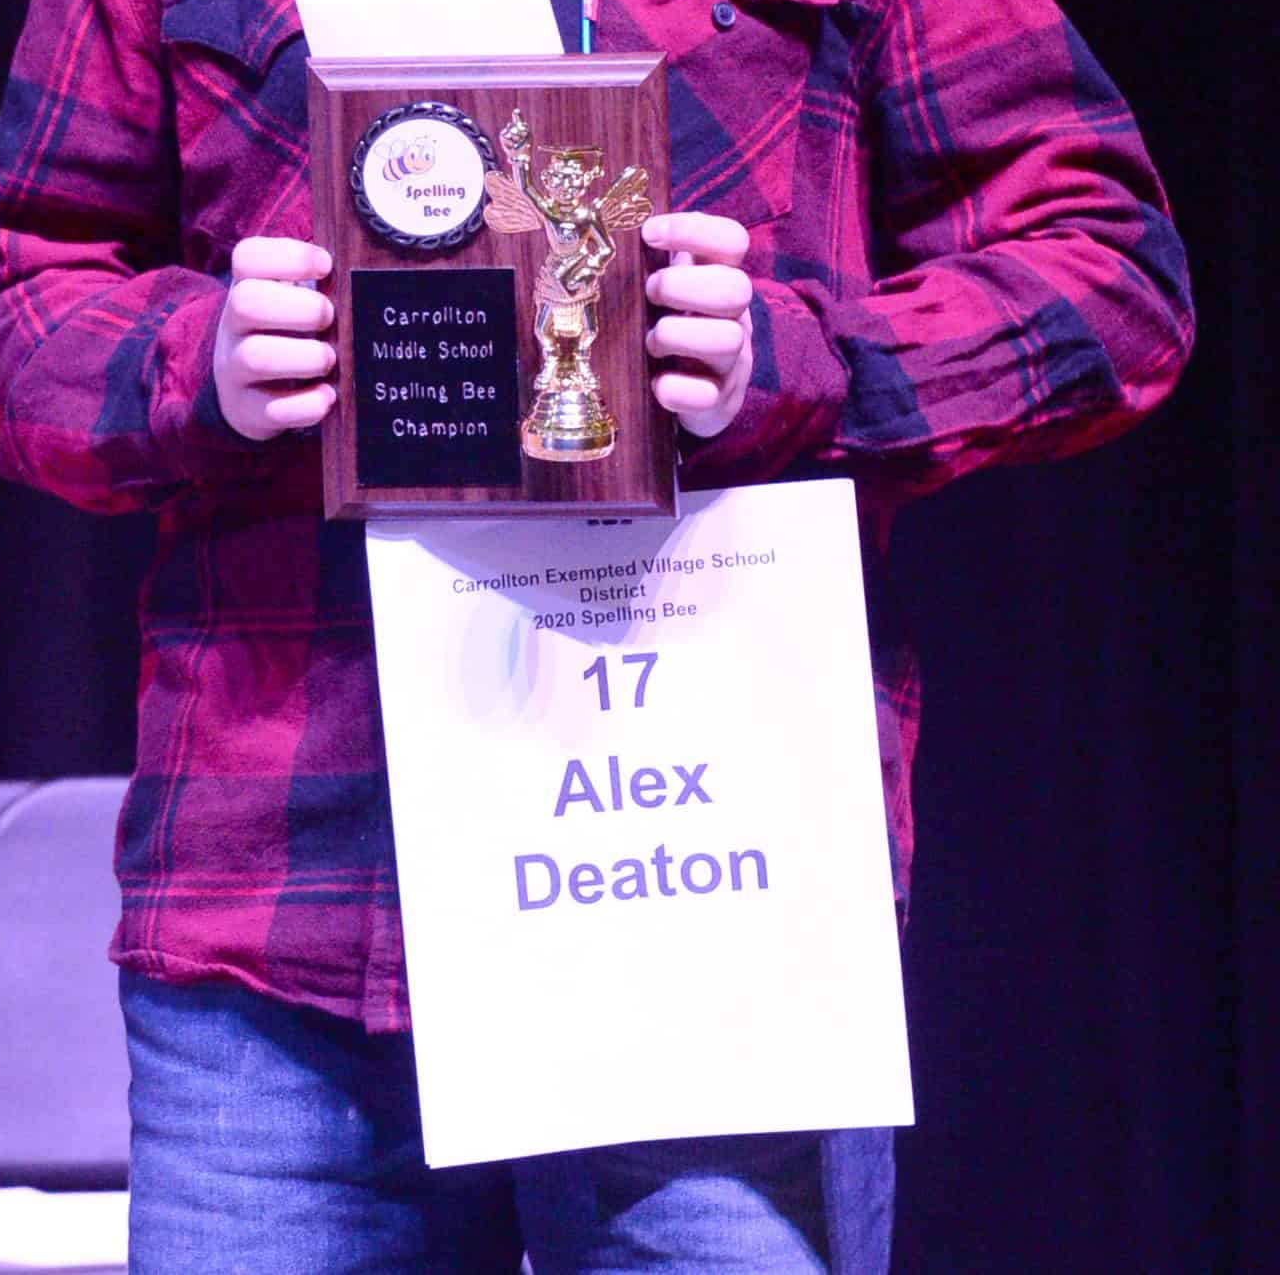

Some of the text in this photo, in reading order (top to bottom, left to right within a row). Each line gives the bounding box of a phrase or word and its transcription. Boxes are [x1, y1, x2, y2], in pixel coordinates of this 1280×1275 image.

[406, 184, 466, 200] Spelling
[423, 205, 451, 217] Bee
[383, 306, 487, 326] Carrollton
[372, 339, 493, 360] Middle School
[375, 381, 496, 404] Spelling Bee
[392, 417, 488, 439] Champion
[452, 548, 776, 595] Carrollton Exempted Village School
[579, 582, 647, 605] District
[534, 601, 698, 630] 2020 Spelling Bee
[582, 651, 660, 712] 17
[553, 755, 713, 818] Alex
[513, 843, 769, 912] Deaton
